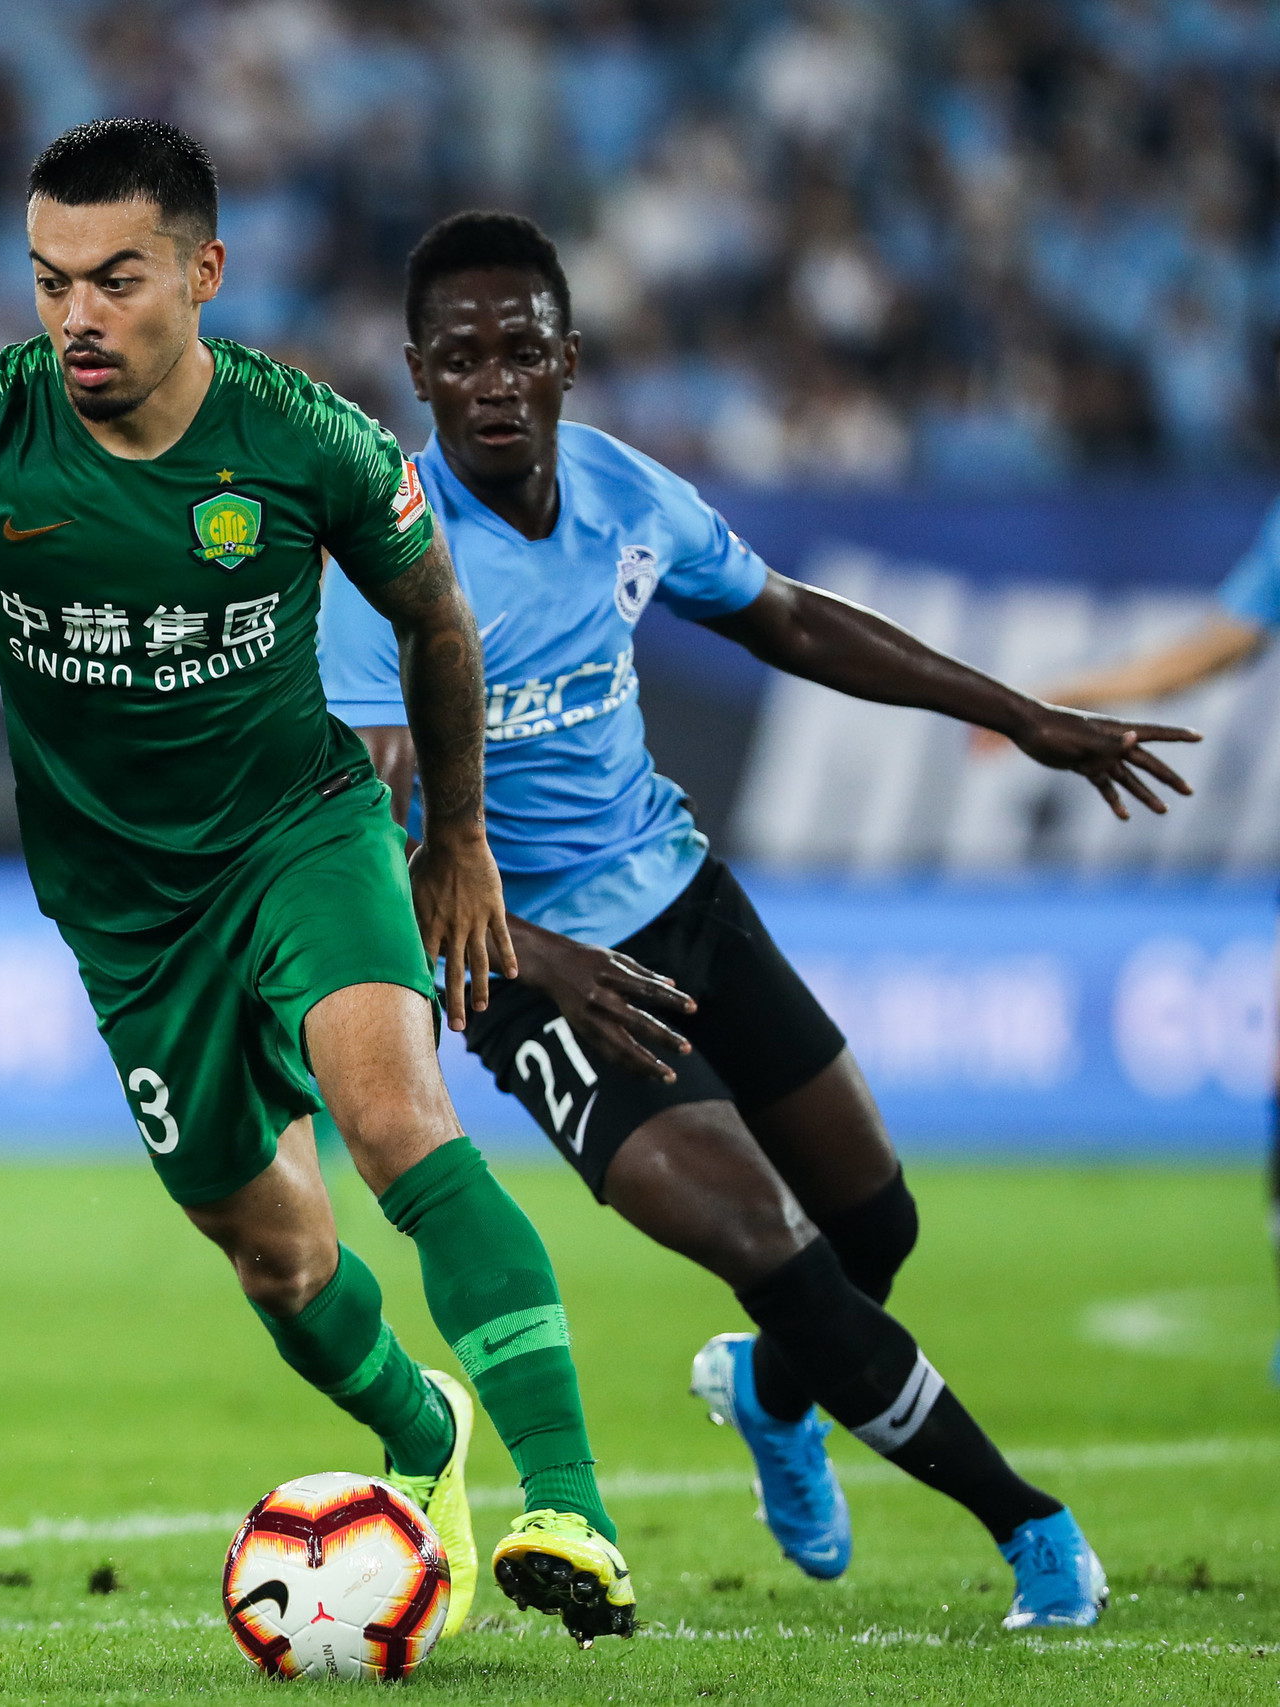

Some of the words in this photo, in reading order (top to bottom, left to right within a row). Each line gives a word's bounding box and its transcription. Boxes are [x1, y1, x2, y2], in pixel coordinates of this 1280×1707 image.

[0, 590, 280, 658] 中赫集团
[9, 637, 133, 688] SINOBO
[154, 632, 275, 692] GROUP
[515, 1016, 599, 1134] 21
